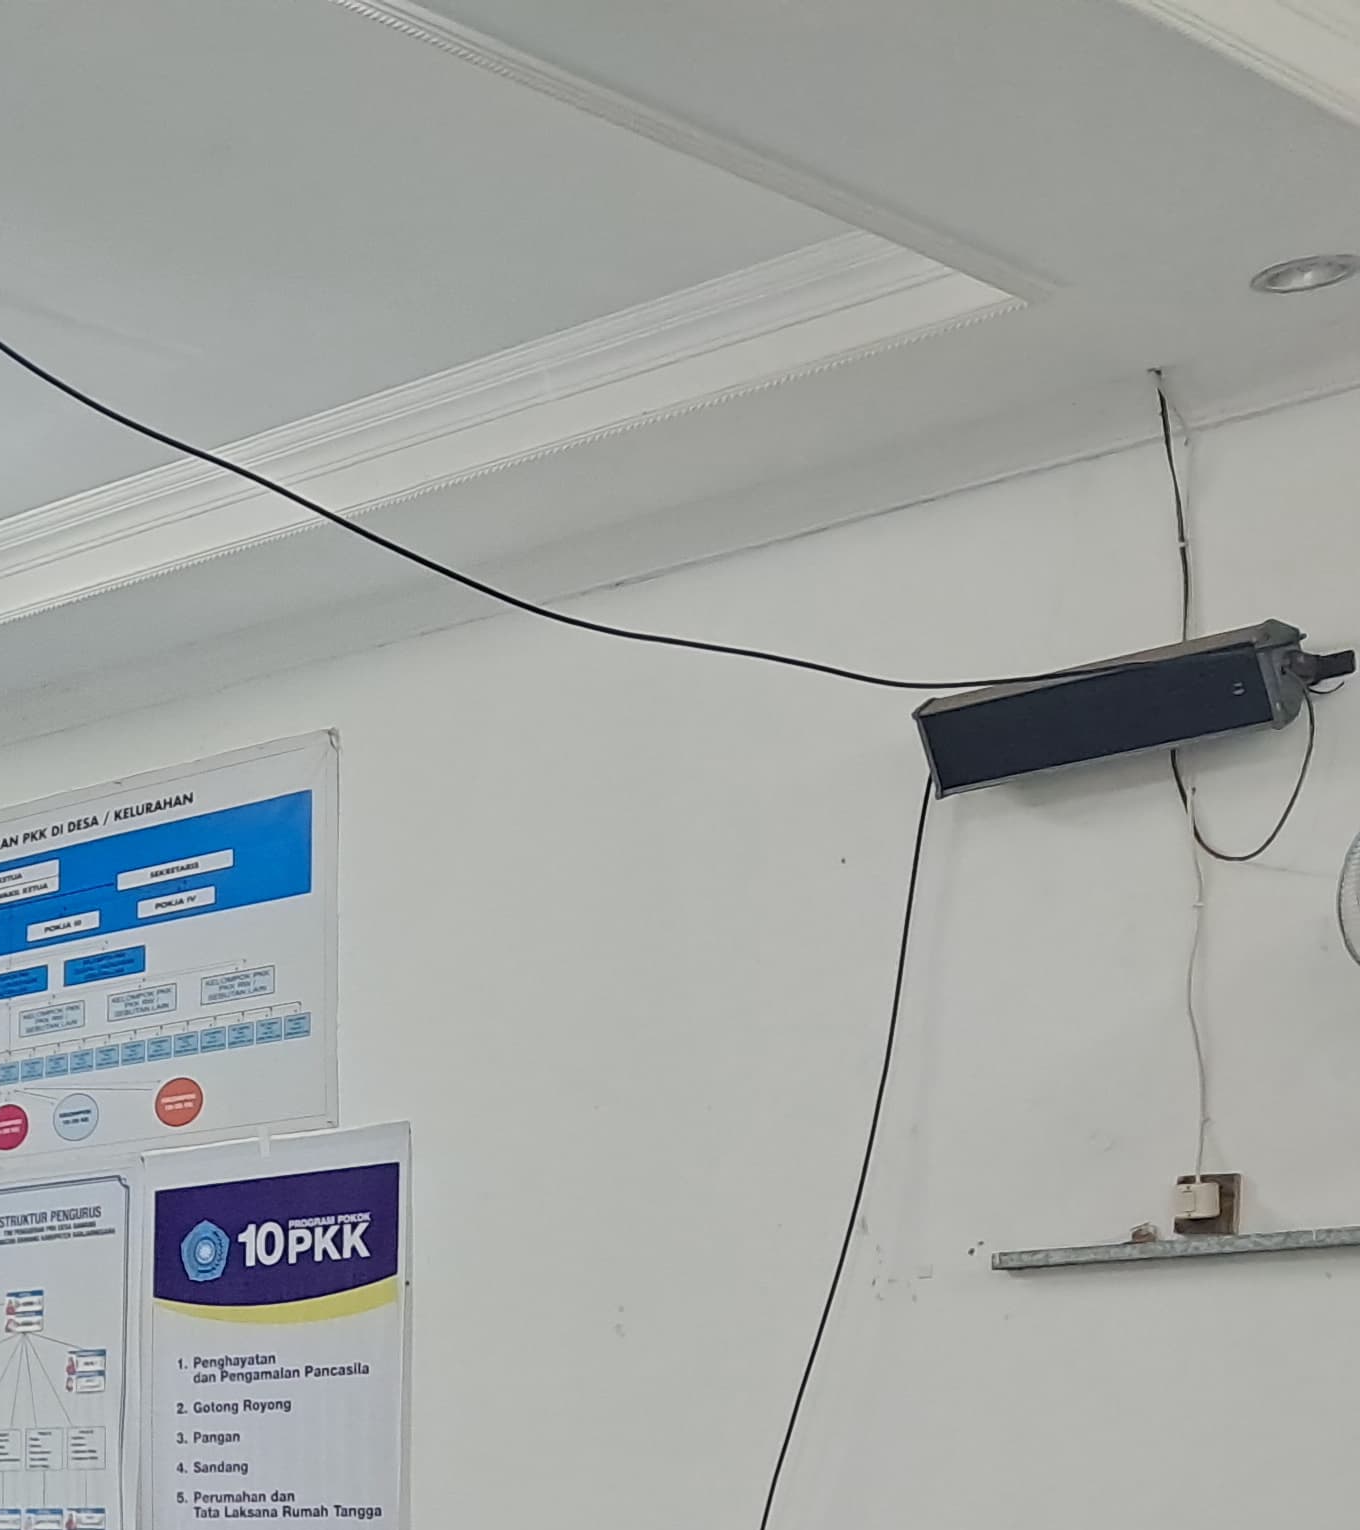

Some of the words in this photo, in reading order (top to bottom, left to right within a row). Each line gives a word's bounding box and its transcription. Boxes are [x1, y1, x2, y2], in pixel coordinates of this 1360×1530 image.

[22, 828, 47, 845] PKK
[51, 824, 64, 838] DI
[68, 815, 99, 834] DESA
[103, 811, 110, 825] /
[114, 792, 194, 821] KELURAHAN
[50, 1205, 102, 1223] PENGURUS
[288, 1215, 336, 1228] PROGRAM
[337, 1211, 371, 1224] POKOK
[177, 1358, 188, 1370] 1.
[193, 1354, 276, 1369] Penghayatan
[193, 1371, 216, 1383] dan
[220, 1367, 300, 1384] Pengamalan
[304, 1362, 370, 1378] Pancasila
[176, 1402, 188, 1414] 2.
[193, 1401, 239, 1415] Gotong
[243, 1399, 292, 1413] Royong
[176, 1432, 188, 1444] 3.
[193, 1431, 241, 1445] Pangan
[176, 1462, 188, 1473] 4.
[193, 1461, 249, 1475] Sandang
[177, 1492, 188, 1503] 5.
[193, 1491, 266, 1503] Perumahan
[270, 1490, 295, 1503] dan
[194, 1506, 220, 1519] Tata
[224, 1506, 278, 1518] Laksana
[282, 1505, 328, 1518] Rumah
[333, 1505, 382, 1520] Tangga
